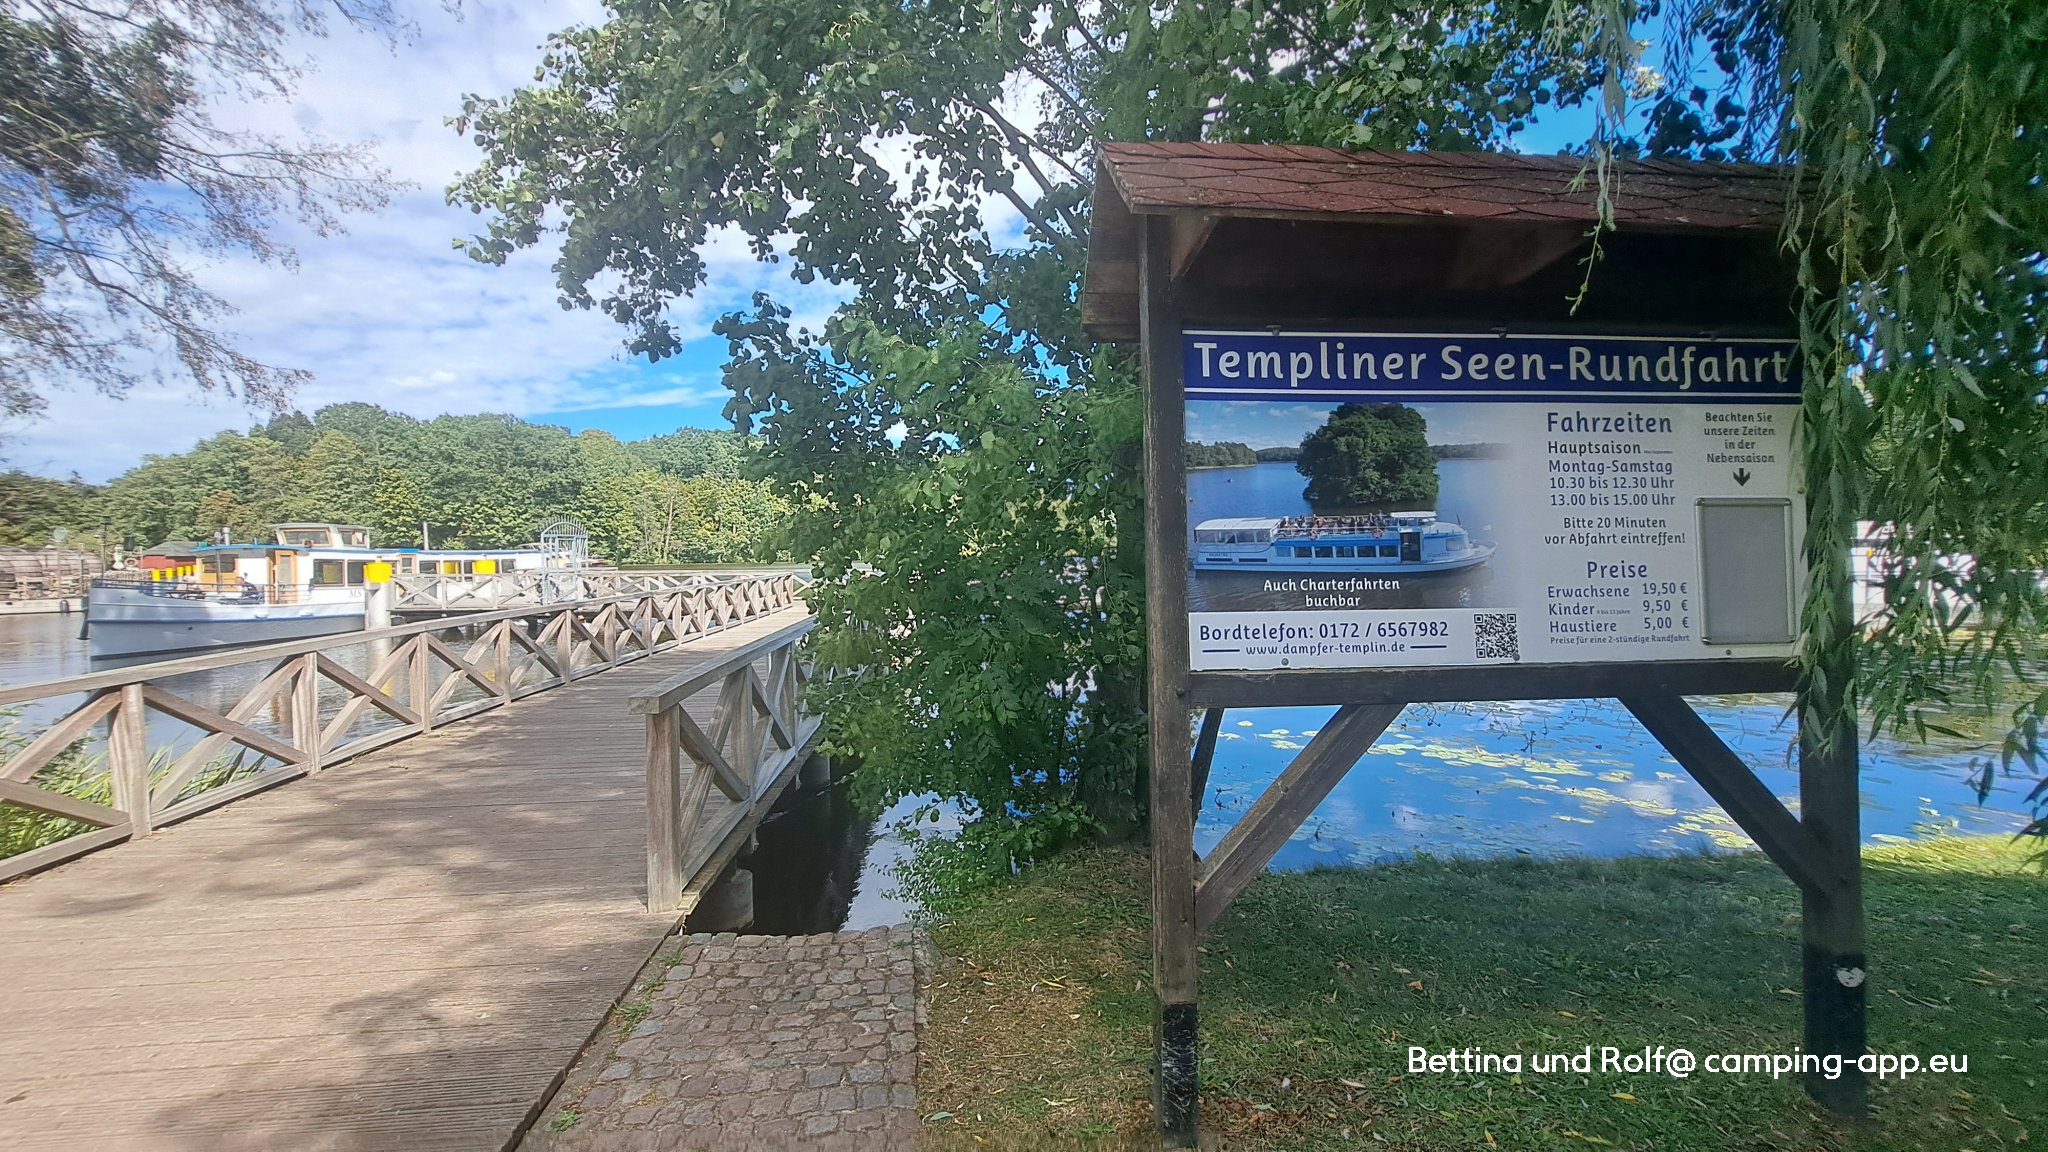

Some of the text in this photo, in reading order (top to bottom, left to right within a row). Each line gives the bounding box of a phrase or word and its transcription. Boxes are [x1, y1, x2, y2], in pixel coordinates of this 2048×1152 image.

[1193, 341, 1788, 389] Templiner Seen-Rundfahrt
[1547, 411, 1672, 433] Fahrzeiten
[1705, 412, 1772, 422] Beachten Sie
[1704, 426, 1775, 436] unsere Zeiten
[1548, 441, 1641, 456] Hauptsaison
[1724, 439, 1756, 449] in der
[1706, 453, 1775, 463] Nebensaison
[1549, 459, 1673, 475] Montag-Samstag
[1550, 476, 1675, 489] 10.30 bis 12.30 Uhr
[1550, 493, 1676, 506] 13.00 bis 15.00 Uhr
[1563, 517, 1666, 529] Bitte 20 Minuten
[1544, 533, 1685, 546] vor Abfahrt eintreffen!
[1587, 560, 1648, 578] Preise
[1264, 578, 1400, 592] Auch Charterfahrten
[1548, 582, 1687, 598] Erwachsene 19,50 €
[1305, 594, 1360, 608] buchbar
[1548, 603, 1595, 615] Kinder
[1642, 600, 1671, 613] 9,50
[1681, 599, 1688, 611] €
[1199, 621, 1449, 642] Bordtelefon: 0172 / 6567982
[1550, 616, 1689, 633] Haustiere 5,00 €
[1550, 634, 1690, 645] Preise für eine 2-stündige Rundfahrt
[1246, 641, 1405, 657] www.dampfer-templin.de
